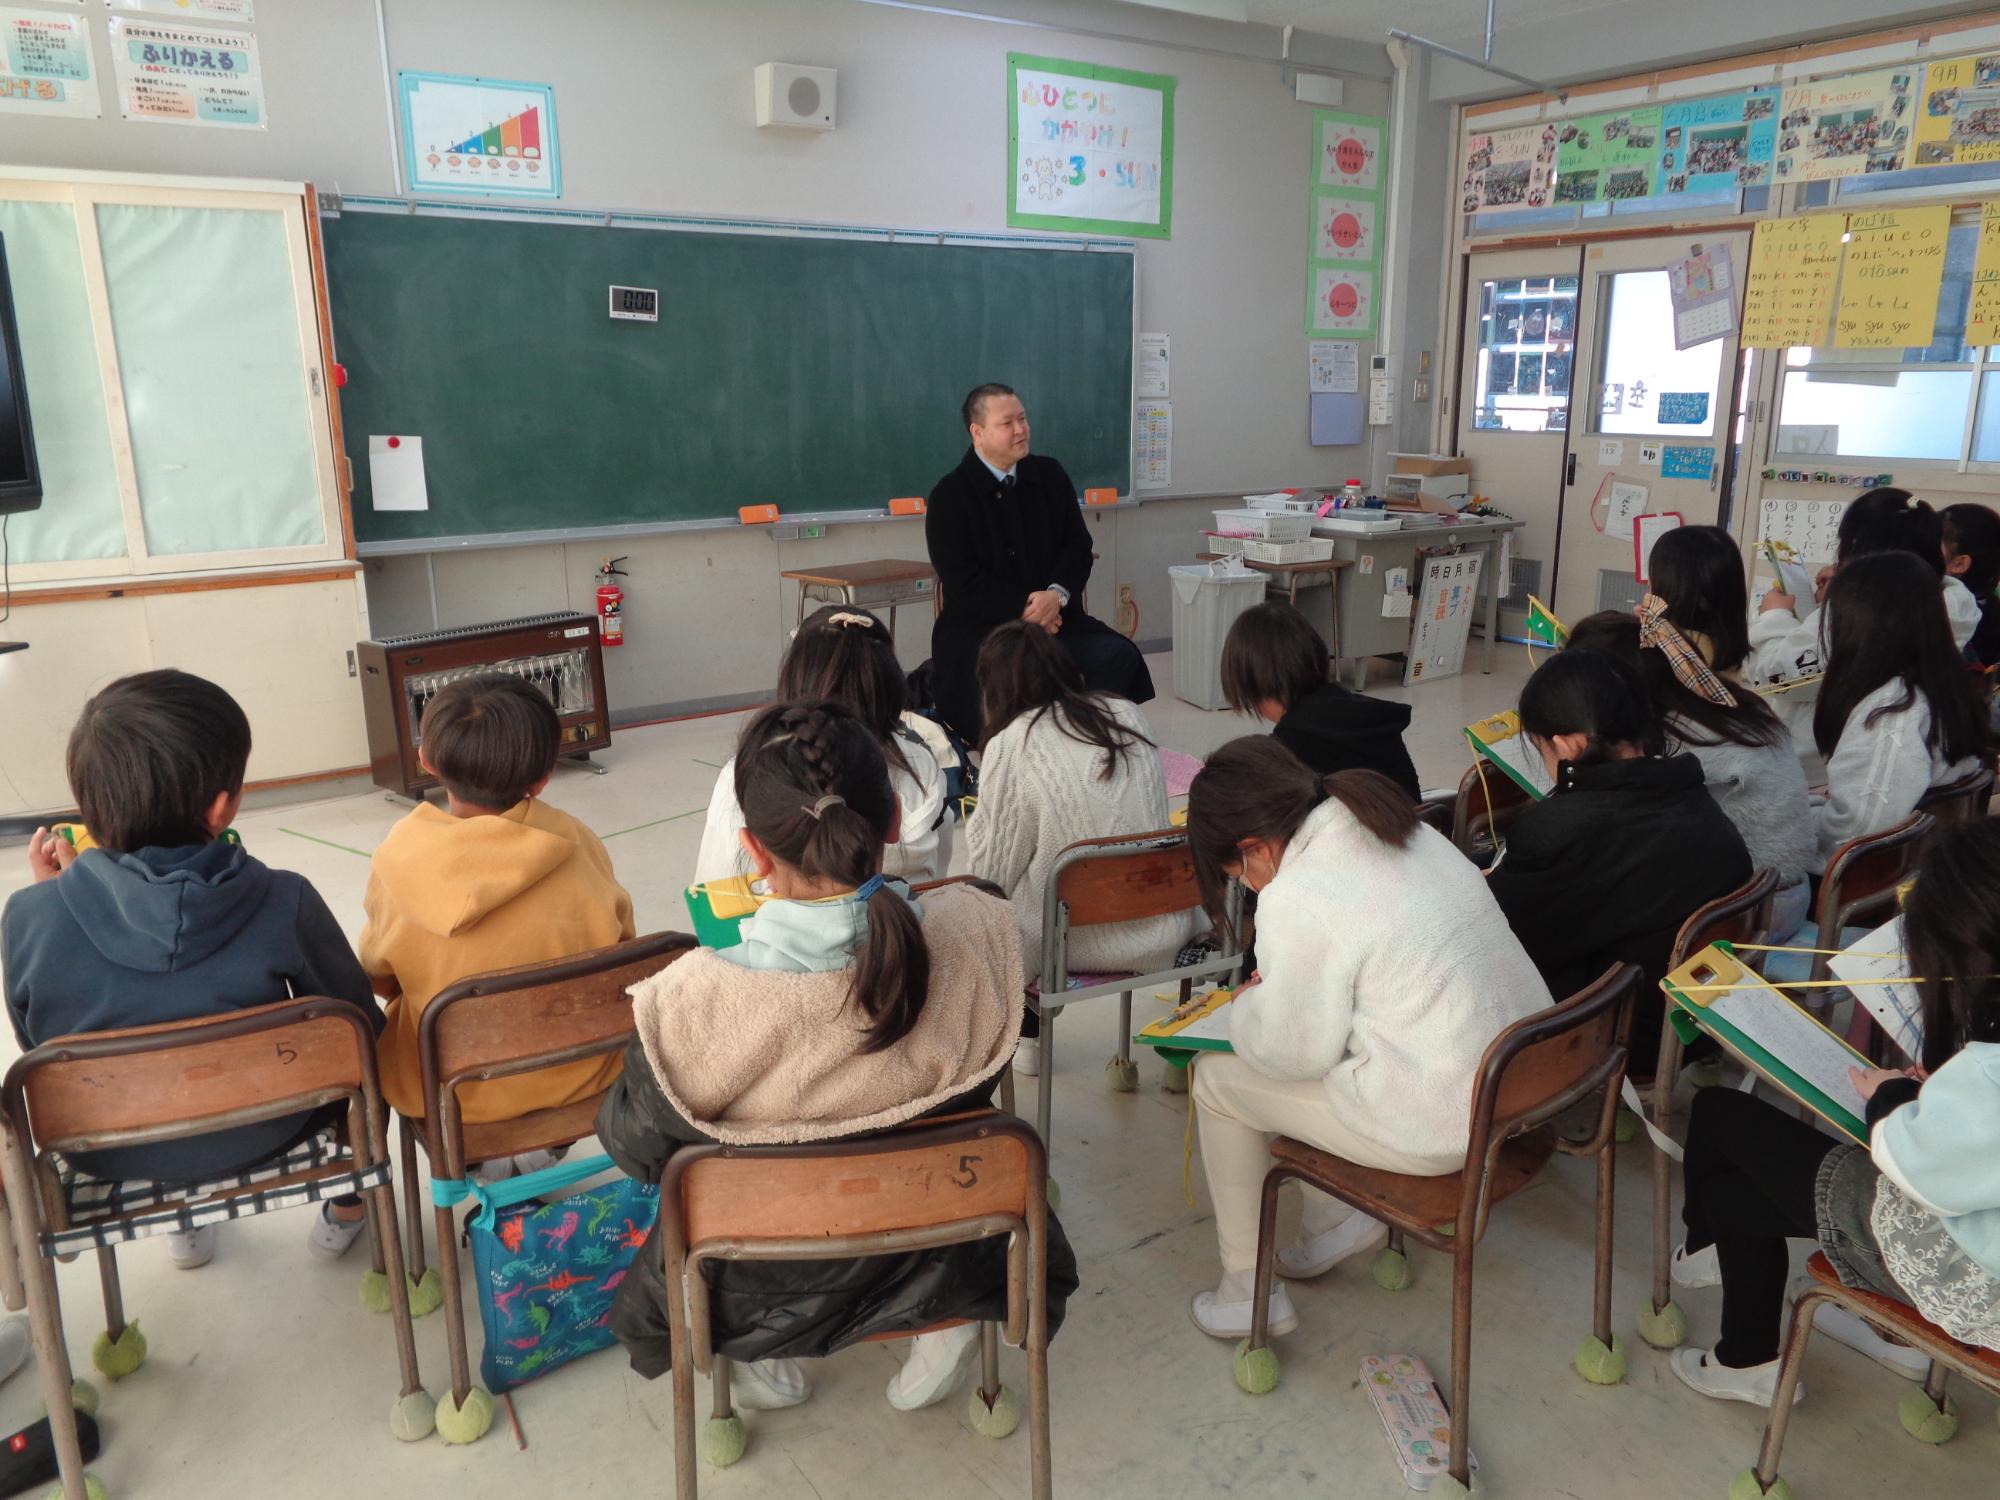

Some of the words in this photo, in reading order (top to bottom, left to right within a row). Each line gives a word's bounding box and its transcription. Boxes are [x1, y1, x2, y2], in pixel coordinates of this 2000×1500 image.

[143, 44, 235, 71] ふりかえる
[1932, 64, 1958, 82] 9月
[0, 79, 58, 100] げる
[1022, 81, 1116, 116] 心ひとつに
[1884, 231, 1893, 242] u
[1902, 231, 1910, 241] e
[1920, 228, 1932, 239] o
[1430, 565, 1440, 579] 時
[1443, 566, 1450, 578] 日
[1455, 563, 1462, 577] 月
[276, 1040, 298, 1065] 5
[951, 1155, 983, 1189] 5
